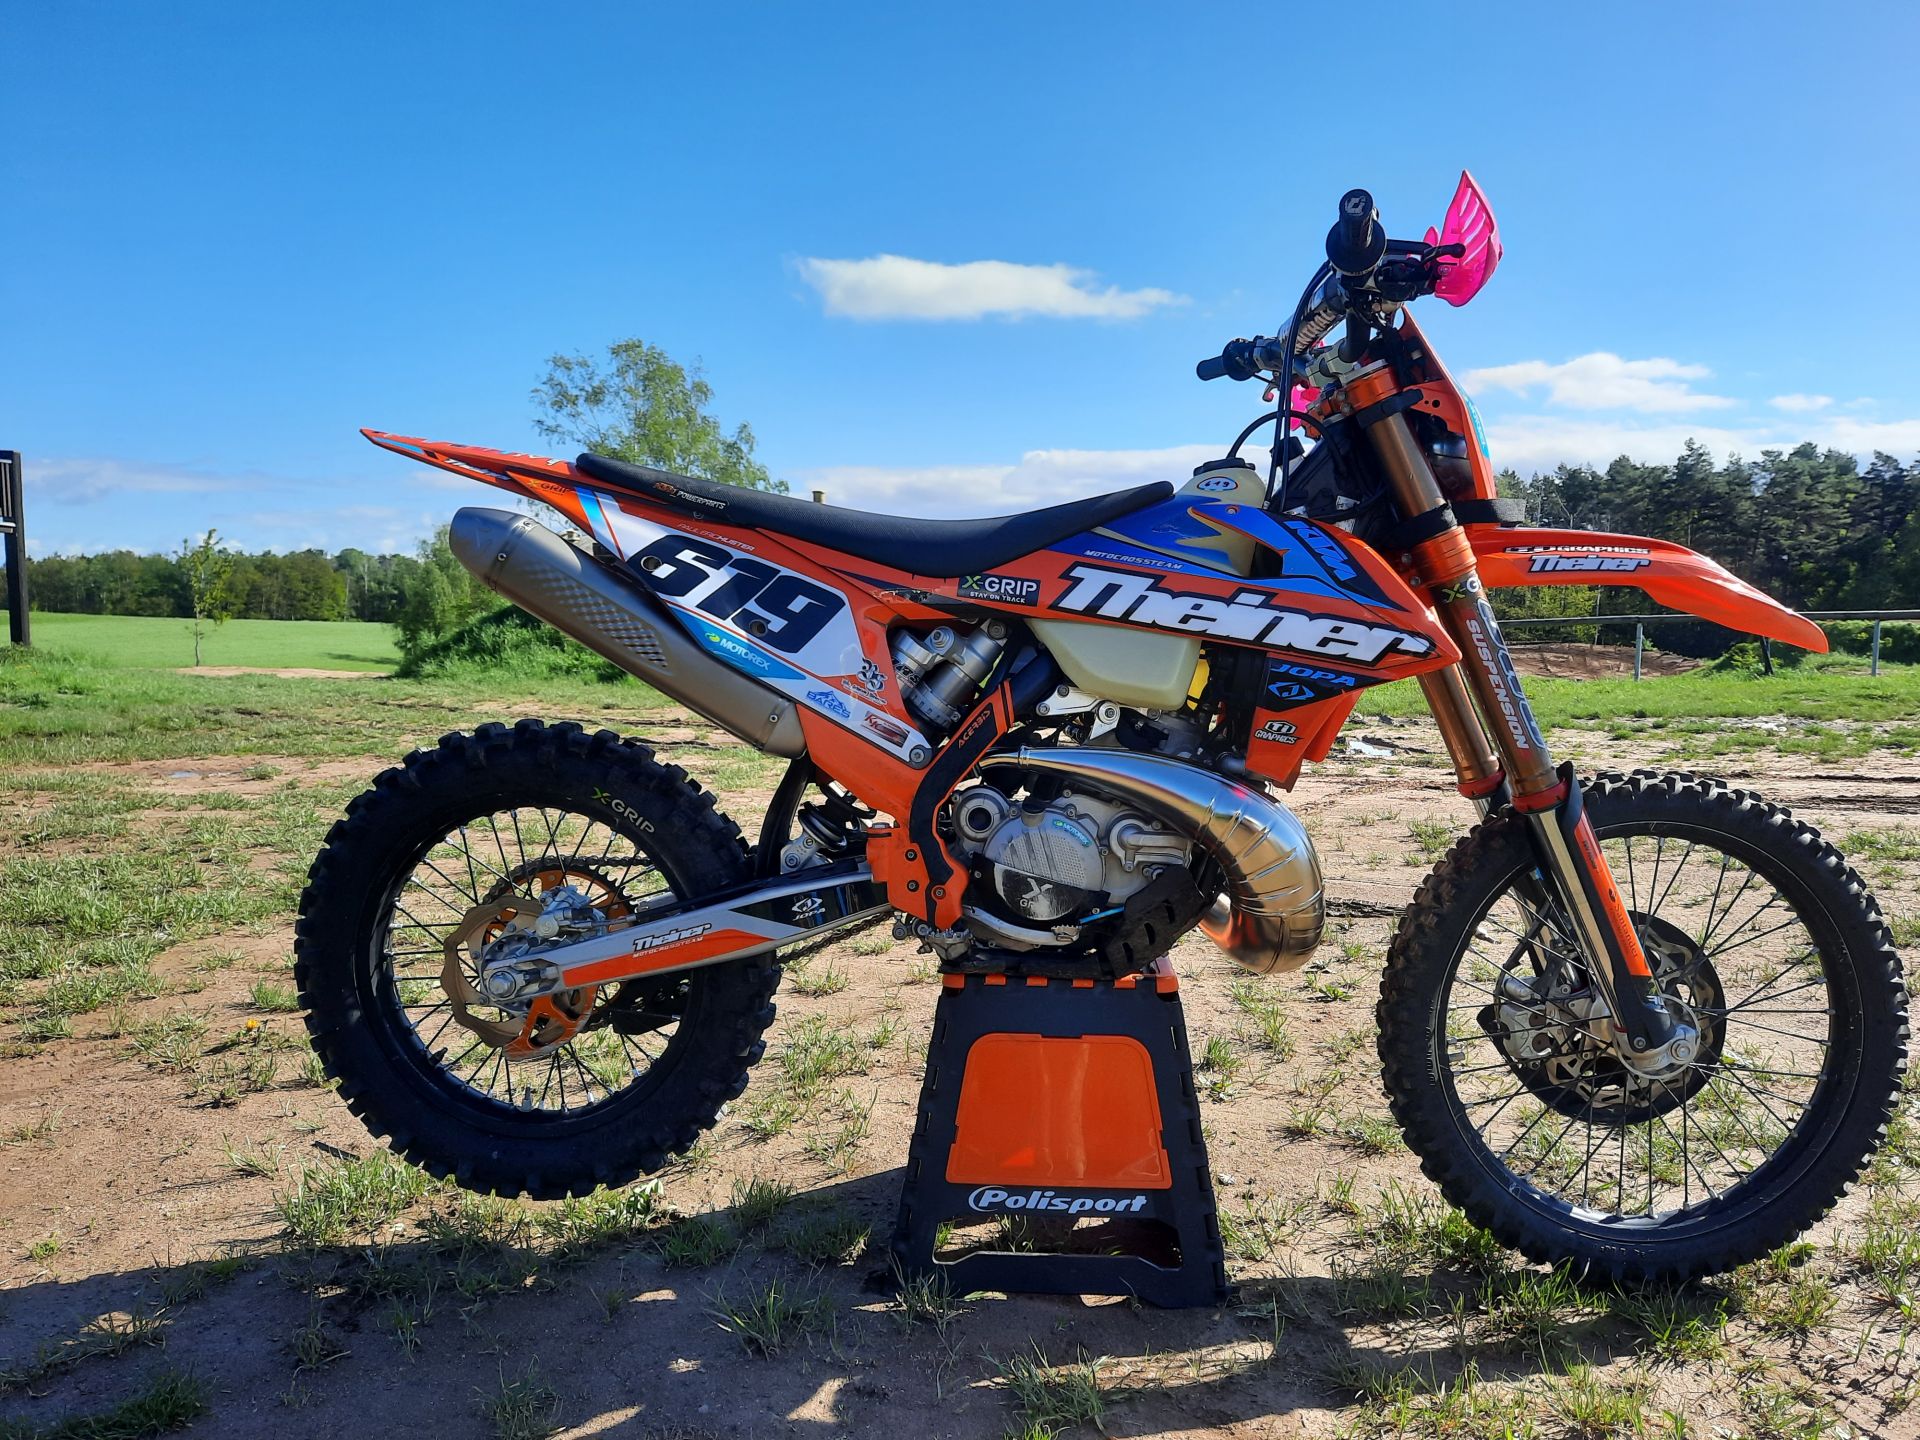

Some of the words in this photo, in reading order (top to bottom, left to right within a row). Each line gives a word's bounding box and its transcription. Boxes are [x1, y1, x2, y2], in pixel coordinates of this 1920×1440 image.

[677, 490, 726, 510] POWERPARTS
[1083, 549, 1184, 571] MOTOCROSSTEAM
[1283, 520, 1357, 582] KTM
[1529, 554, 1650, 572] Theiner
[626, 534, 846, 654] 619
[964, 574, 1037, 597] X-GRIP
[969, 591, 988, 600] STAY
[990, 593, 1001, 601] ON
[1002, 594, 1026, 604] TRACK
[1056, 566, 1430, 661] Theiner
[719, 637, 771, 672] MOTOREX
[1270, 664, 1356, 687] JOPA
[1465, 618, 1530, 750] SUSPENSION
[1254, 729, 1298, 744] GRAPHICS
[591, 786, 655, 834] X-GRIP
[634, 923, 712, 950] Theiner
[1614, 903, 1639, 959] Santander
[970, 1186, 1148, 1214] Polisport
